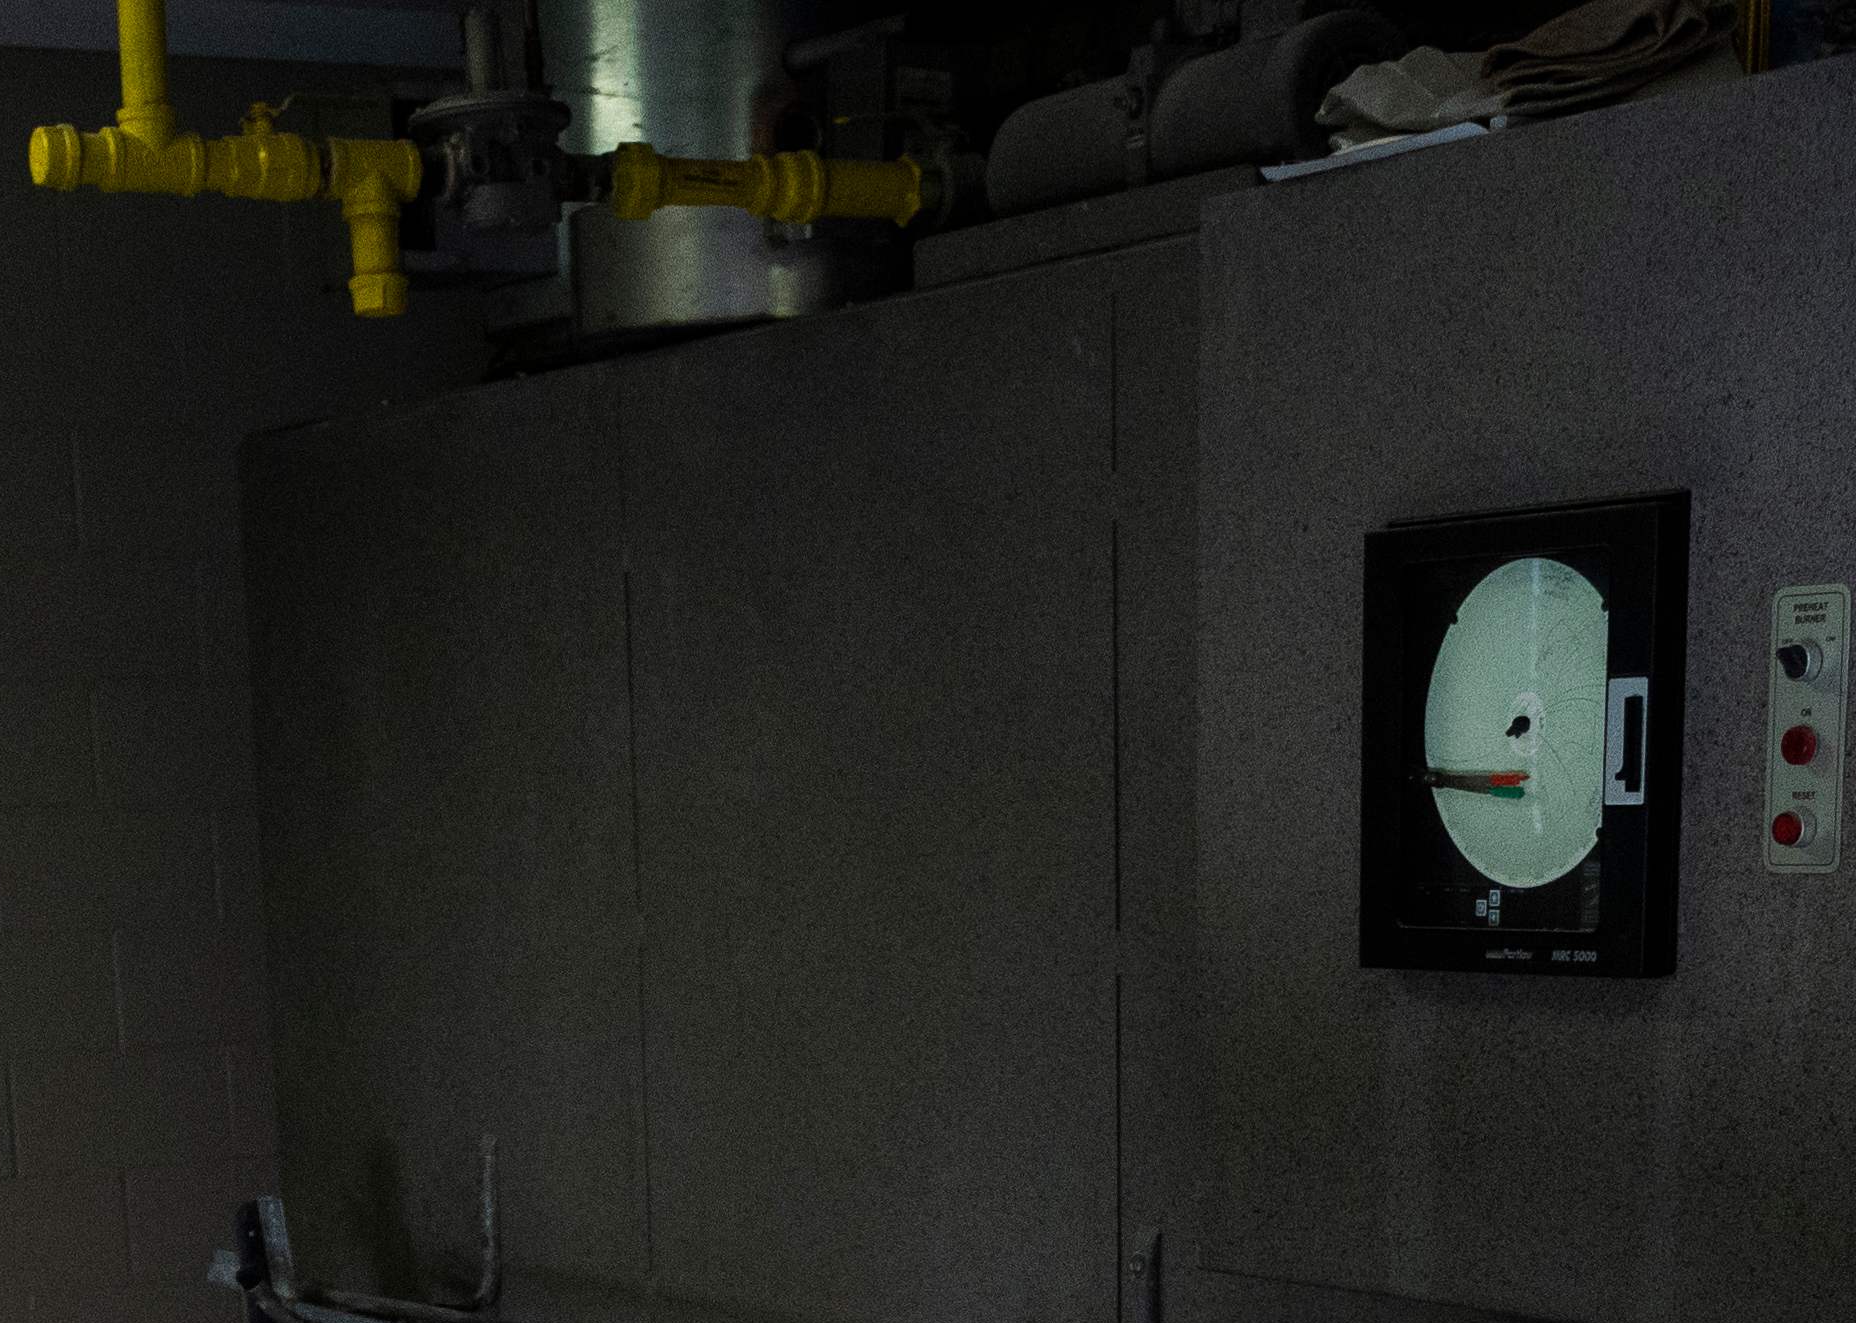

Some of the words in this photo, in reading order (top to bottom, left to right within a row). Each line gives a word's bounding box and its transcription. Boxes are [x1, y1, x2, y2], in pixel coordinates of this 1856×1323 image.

[1794, 601, 1828, 613] PREHEAT
[1795, 613, 1826, 625] BURNER
[1792, 790, 1816, 801] RESET
